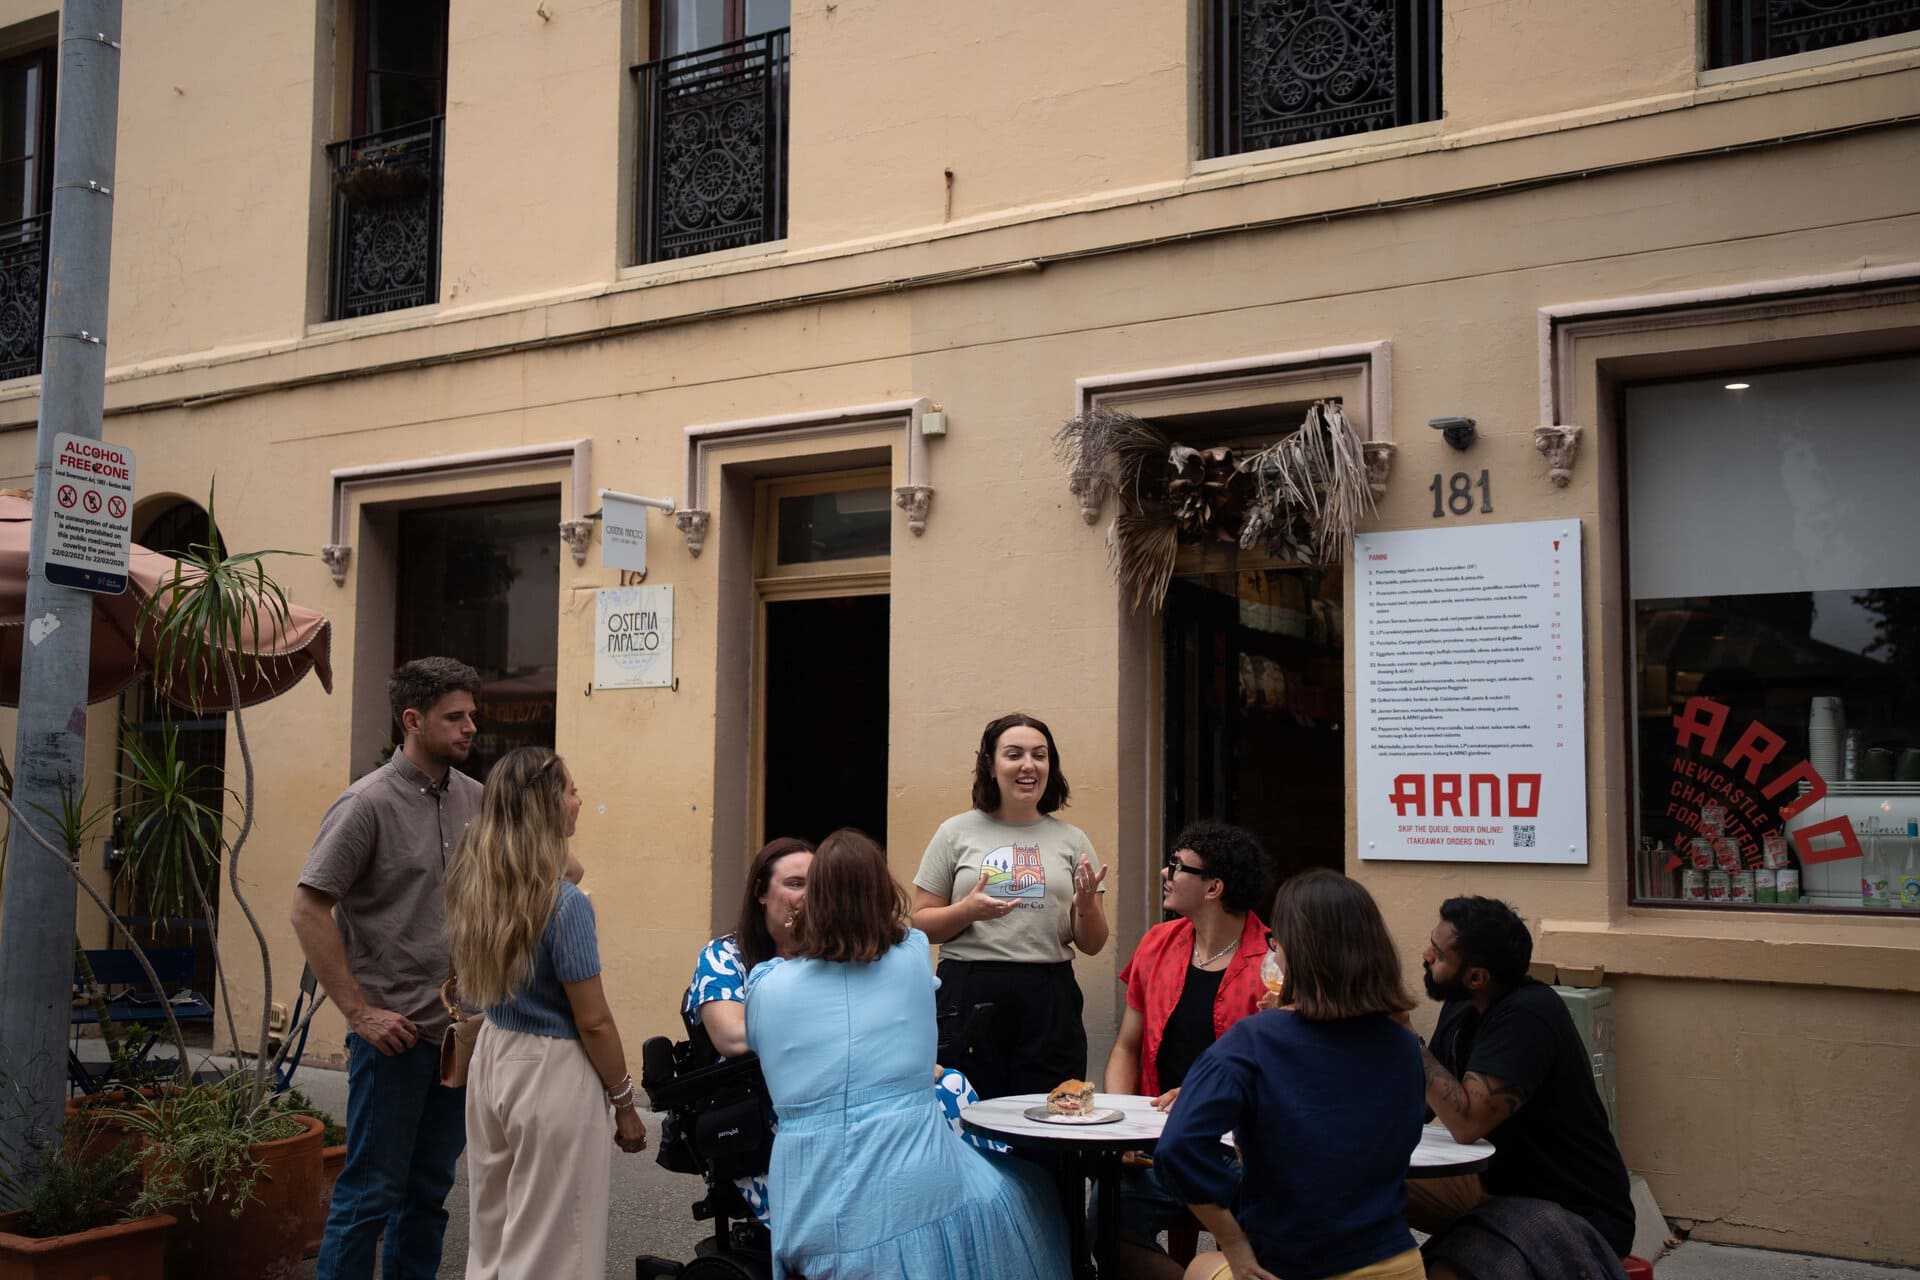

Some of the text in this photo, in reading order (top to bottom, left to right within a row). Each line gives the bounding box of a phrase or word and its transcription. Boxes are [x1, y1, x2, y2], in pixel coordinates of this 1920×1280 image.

[65, 441, 126, 465] ALCOHOL
[60, 454, 129, 480] FREE ZONE
[1429, 469, 1494, 518] 181
[65, 514, 100, 526] consumption
[108, 523, 129, 532] alcohol
[65, 524, 84, 533] always
[85, 527, 113, 538] prohibited
[58, 531, 68, 539] this
[69, 533, 86, 542] public
[62, 542, 87, 552] covering
[608, 611, 658, 633] OSTERIA
[608, 631, 659, 652] PAPAZZO
[1673, 696, 1864, 865] ARNO
[1388, 774, 1542, 817] ARNO
[1672, 758, 1791, 869] NEWCASTLE DELI
[1398, 825, 1503, 834] SKIP THE QUEUE, ORDER ONLINE!
[1670, 781, 1764, 872] CHARCUTERIE
[1407, 837, 1495, 846] (TAKEAWAY ORDERS ONLY)
